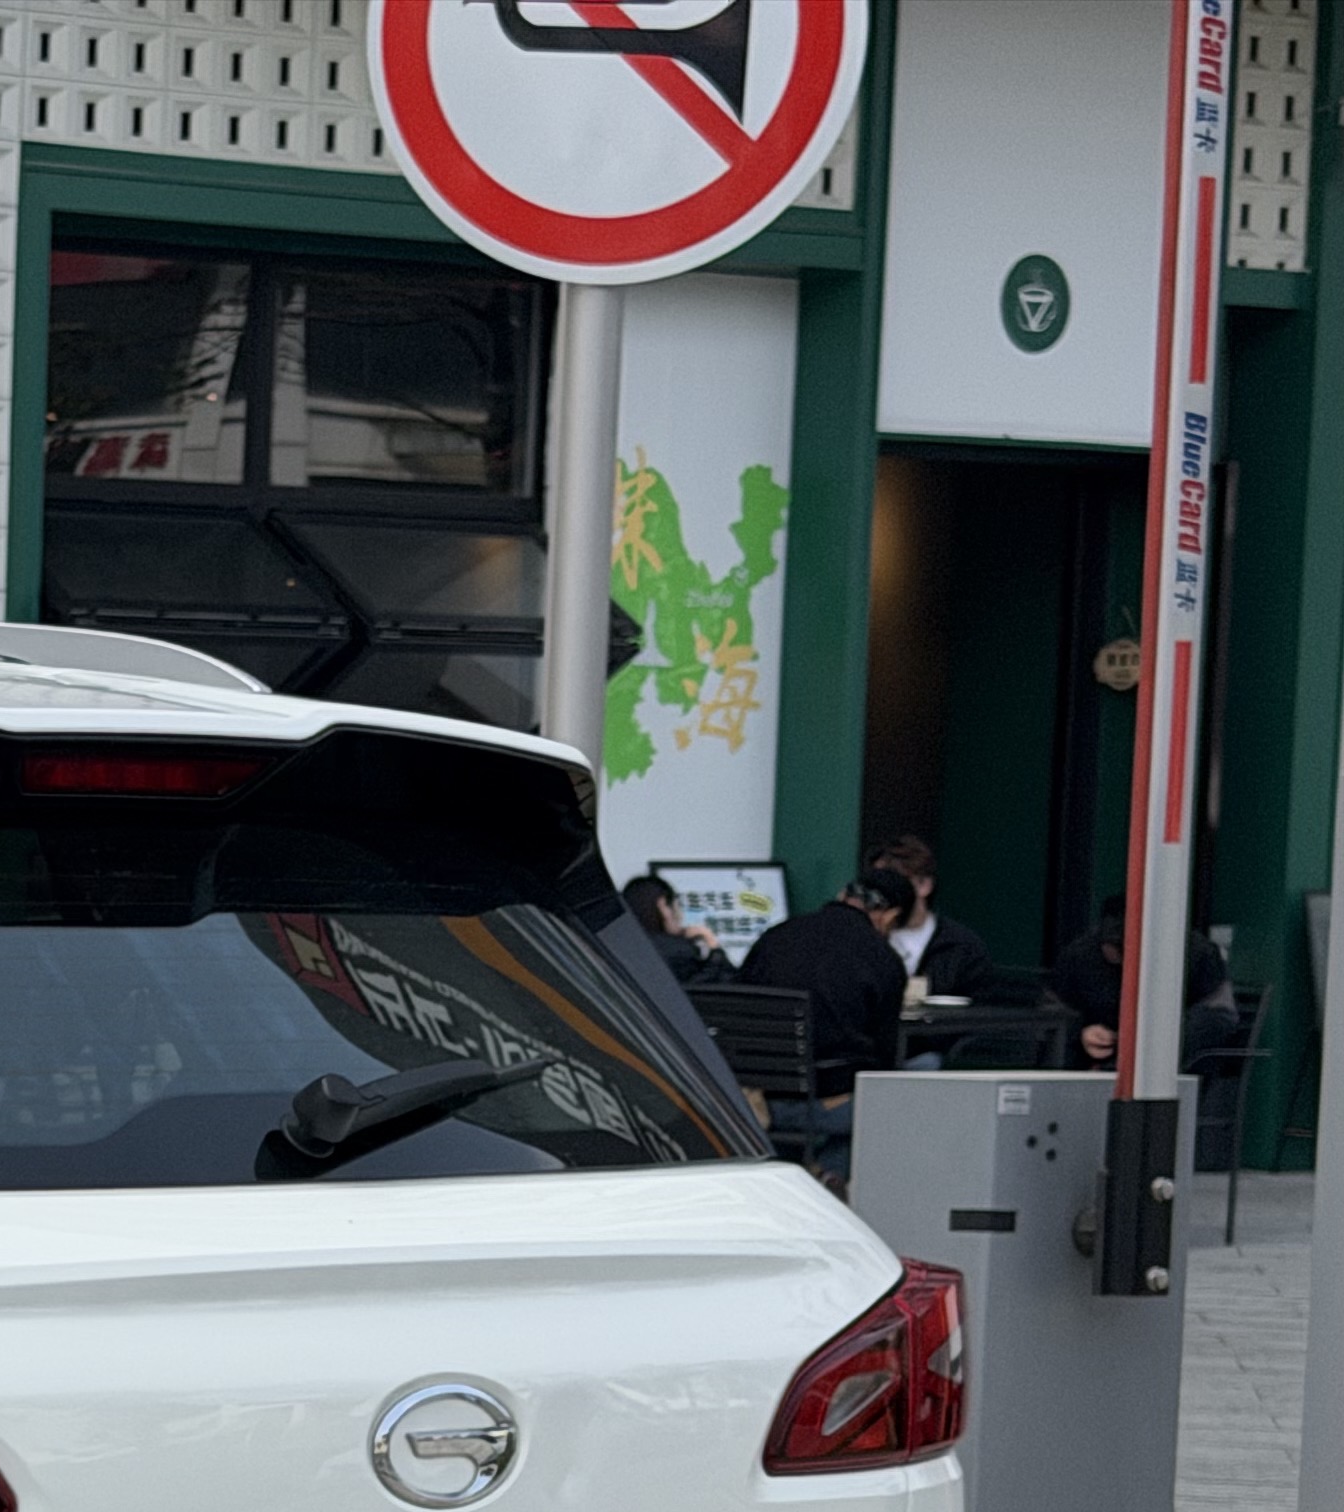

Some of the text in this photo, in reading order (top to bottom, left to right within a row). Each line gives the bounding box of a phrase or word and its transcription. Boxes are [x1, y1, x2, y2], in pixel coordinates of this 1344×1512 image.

[1192, 97, 1220, 154] 蓝卡
[1174, 411, 1208, 613] BlueCard 蓝卡
